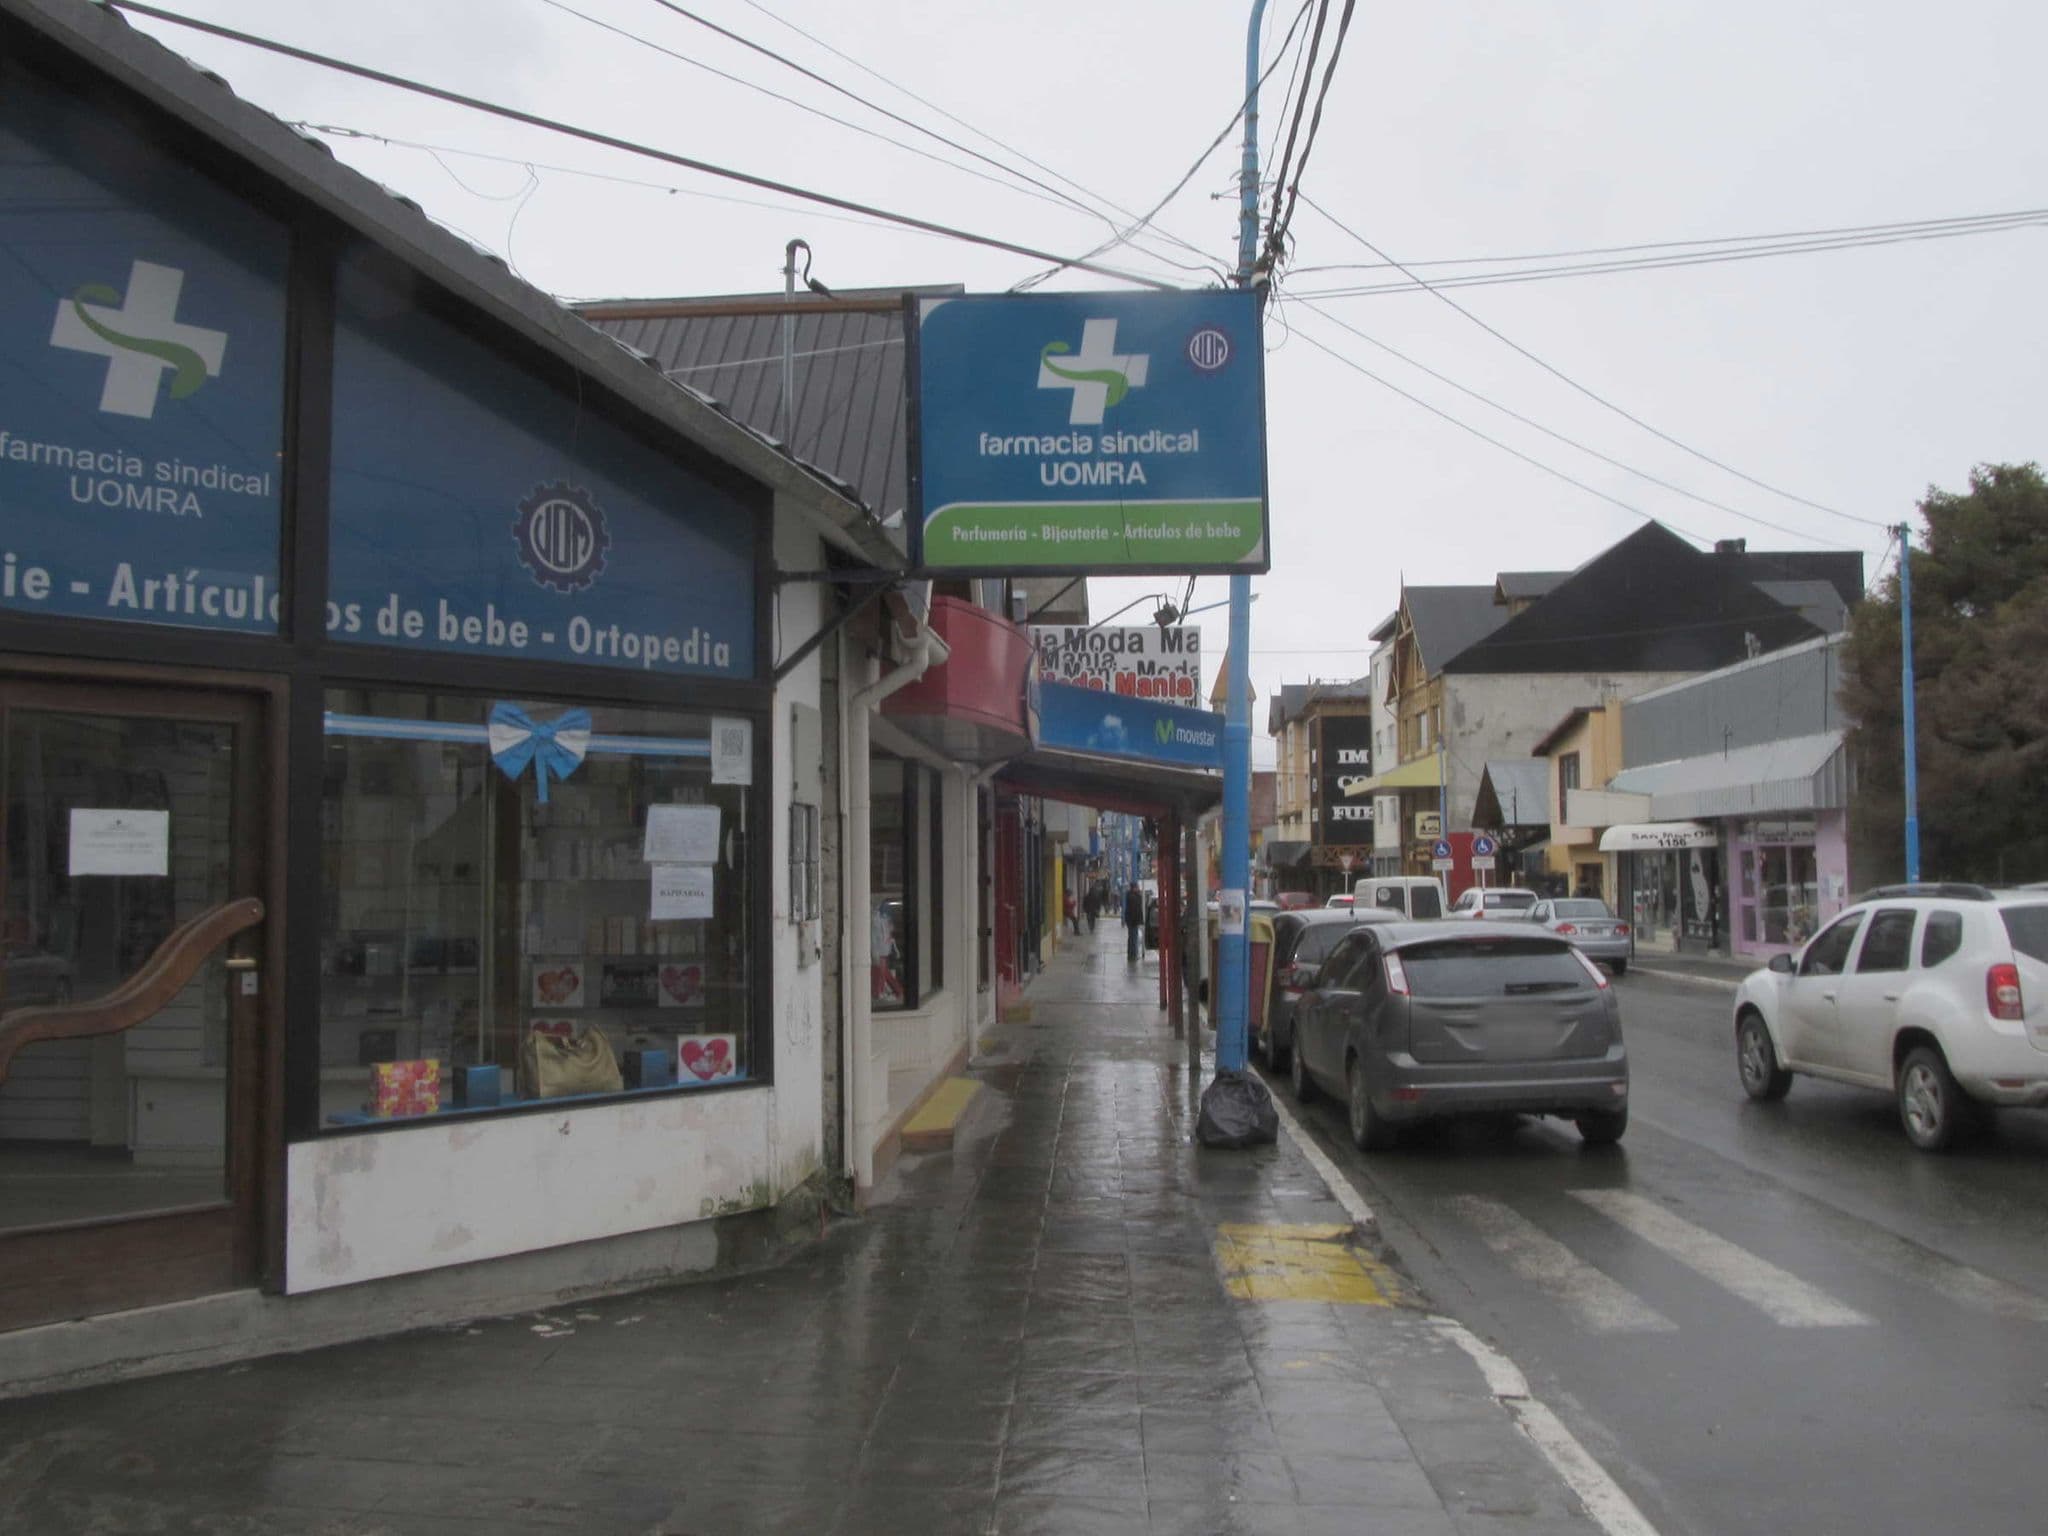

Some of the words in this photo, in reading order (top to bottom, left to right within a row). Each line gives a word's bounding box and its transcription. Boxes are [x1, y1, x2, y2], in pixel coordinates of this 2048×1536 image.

[979, 431, 1093, 456] farmacia
[1101, 429, 1198, 453] sindical
[0, 432, 143, 478] farmacia
[155, 458, 270, 497] sindical
[1040, 461, 1147, 487] UOMRA
[70, 475, 202, 518] UOMRA
[1185, 521, 1202, 539] de
[1206, 521, 1241, 539] bebe
[377, 593, 424, 639] de
[438, 598, 529, 649] bebe
[568, 615, 731, 669] Ortopedia
[1063, 627, 1144, 654] Moda
[1114, 671, 1194, 698] Mania
[1175, 728, 1216, 747] movistar
[1337, 749, 1369, 764] IM
